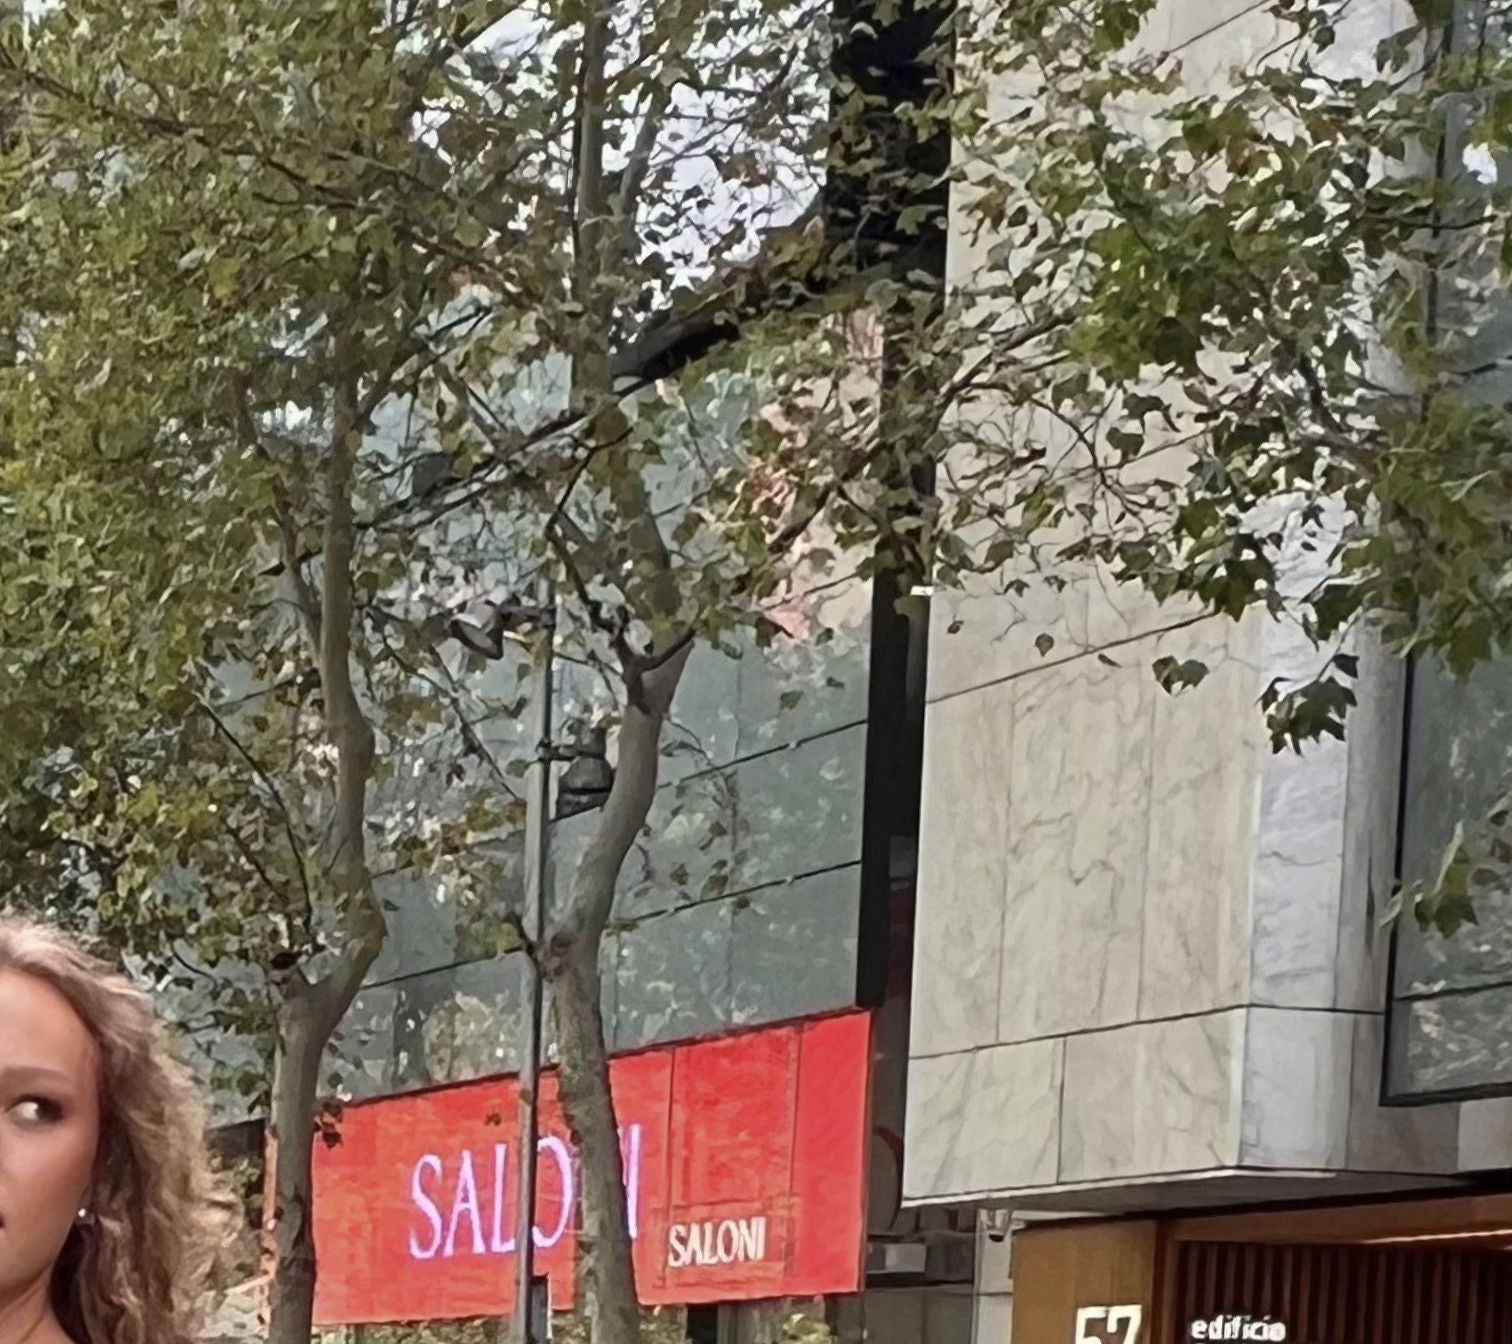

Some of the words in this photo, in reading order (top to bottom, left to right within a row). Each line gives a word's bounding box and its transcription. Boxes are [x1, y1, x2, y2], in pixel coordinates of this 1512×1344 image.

[409, 1122, 641, 1260] SALOI
[669, 1216, 766, 1267] SALONI
[1191, 1314, 1286, 1342] edificio
